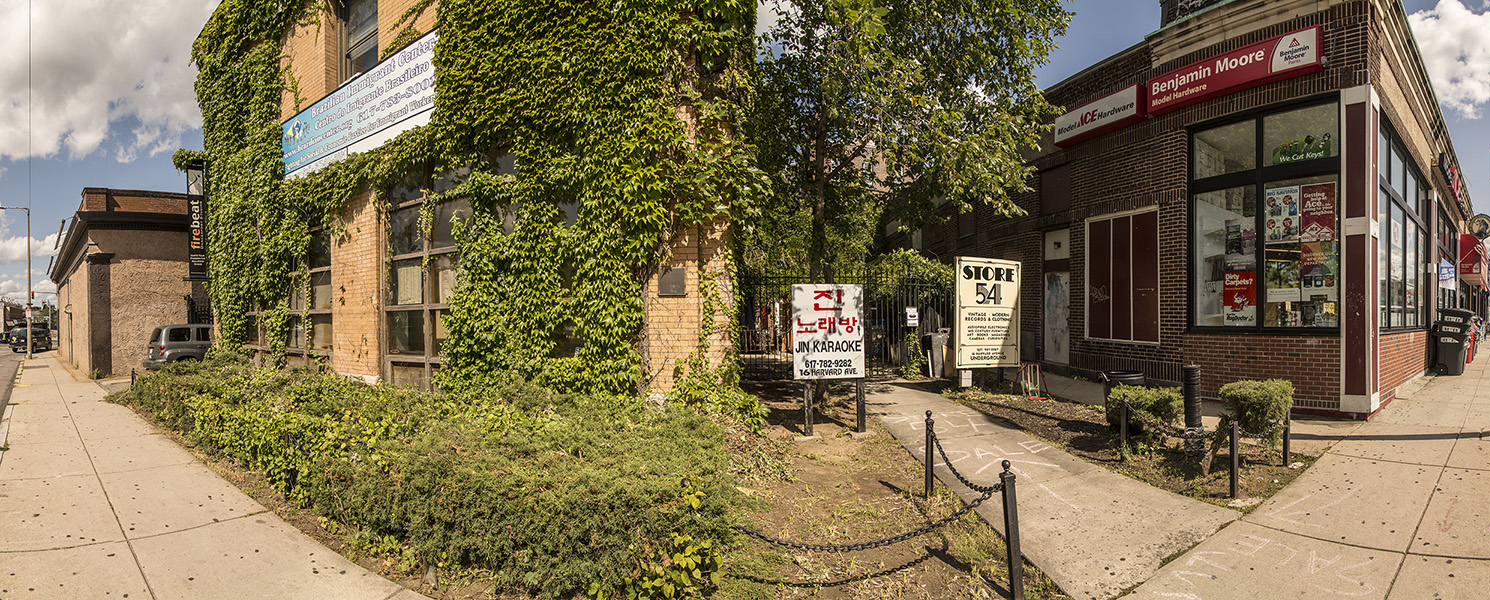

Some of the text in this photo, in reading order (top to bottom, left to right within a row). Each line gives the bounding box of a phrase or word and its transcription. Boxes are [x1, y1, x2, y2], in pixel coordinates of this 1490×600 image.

[1280, 45, 1309, 57] Benjamin
[1284, 52, 1305, 61] Moore
[311, 37, 435, 119] Brazilian Immigrant Center
[1152, 50, 1265, 95] Benjamin Moore
[314, 61, 430, 130] Centro do Imigrante Brasileiro
[1152, 83, 1207, 107] Model Hardware
[376, 105, 409, 130] Immigrant
[1058, 102, 1134, 135] Model ACE Hardware
[1306, 150, 1324, 159] Keys!
[190, 200, 200, 249] firebeat
[962, 265, 1015, 282] STORE
[813, 289, 842, 311] 진
[976, 282, 1002, 305] 54
[796, 317, 858, 333] 노래방
[795, 340, 862, 353] JIN KARAOKE
[805, 359, 852, 368] 617-782-9282
[811, 368, 842, 376] HARVARD
[918, 440, 1052, 467] SALE
